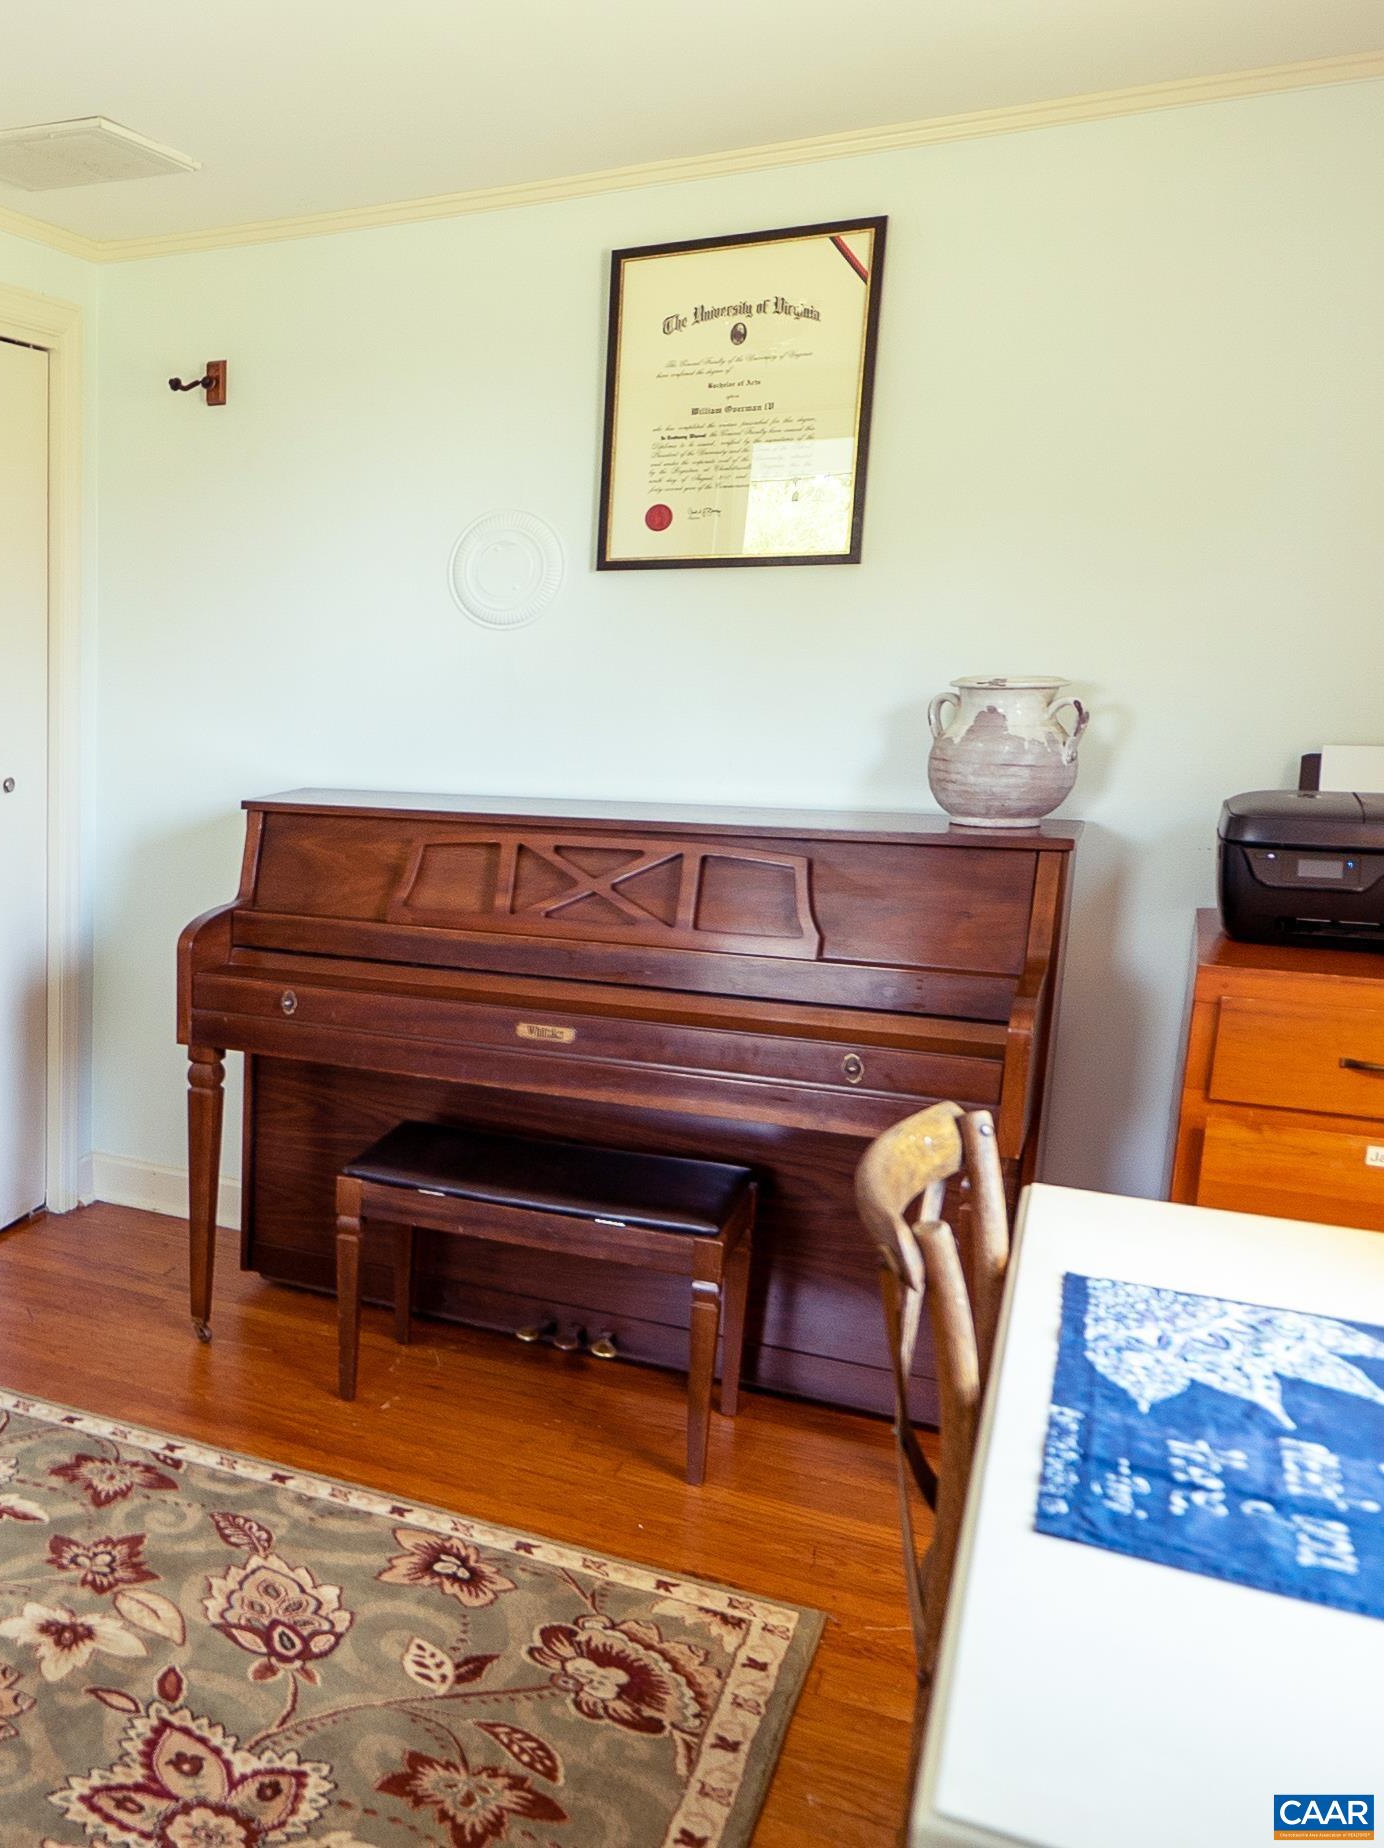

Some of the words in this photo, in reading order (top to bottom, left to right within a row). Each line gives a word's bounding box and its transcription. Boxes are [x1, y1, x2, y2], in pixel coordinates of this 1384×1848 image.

[663, 314, 687, 335] The
[692, 301, 753, 325] University
[756, 300, 770, 314] of
[774, 296, 821, 322] Virginia
[691, 407, 722, 415] William
